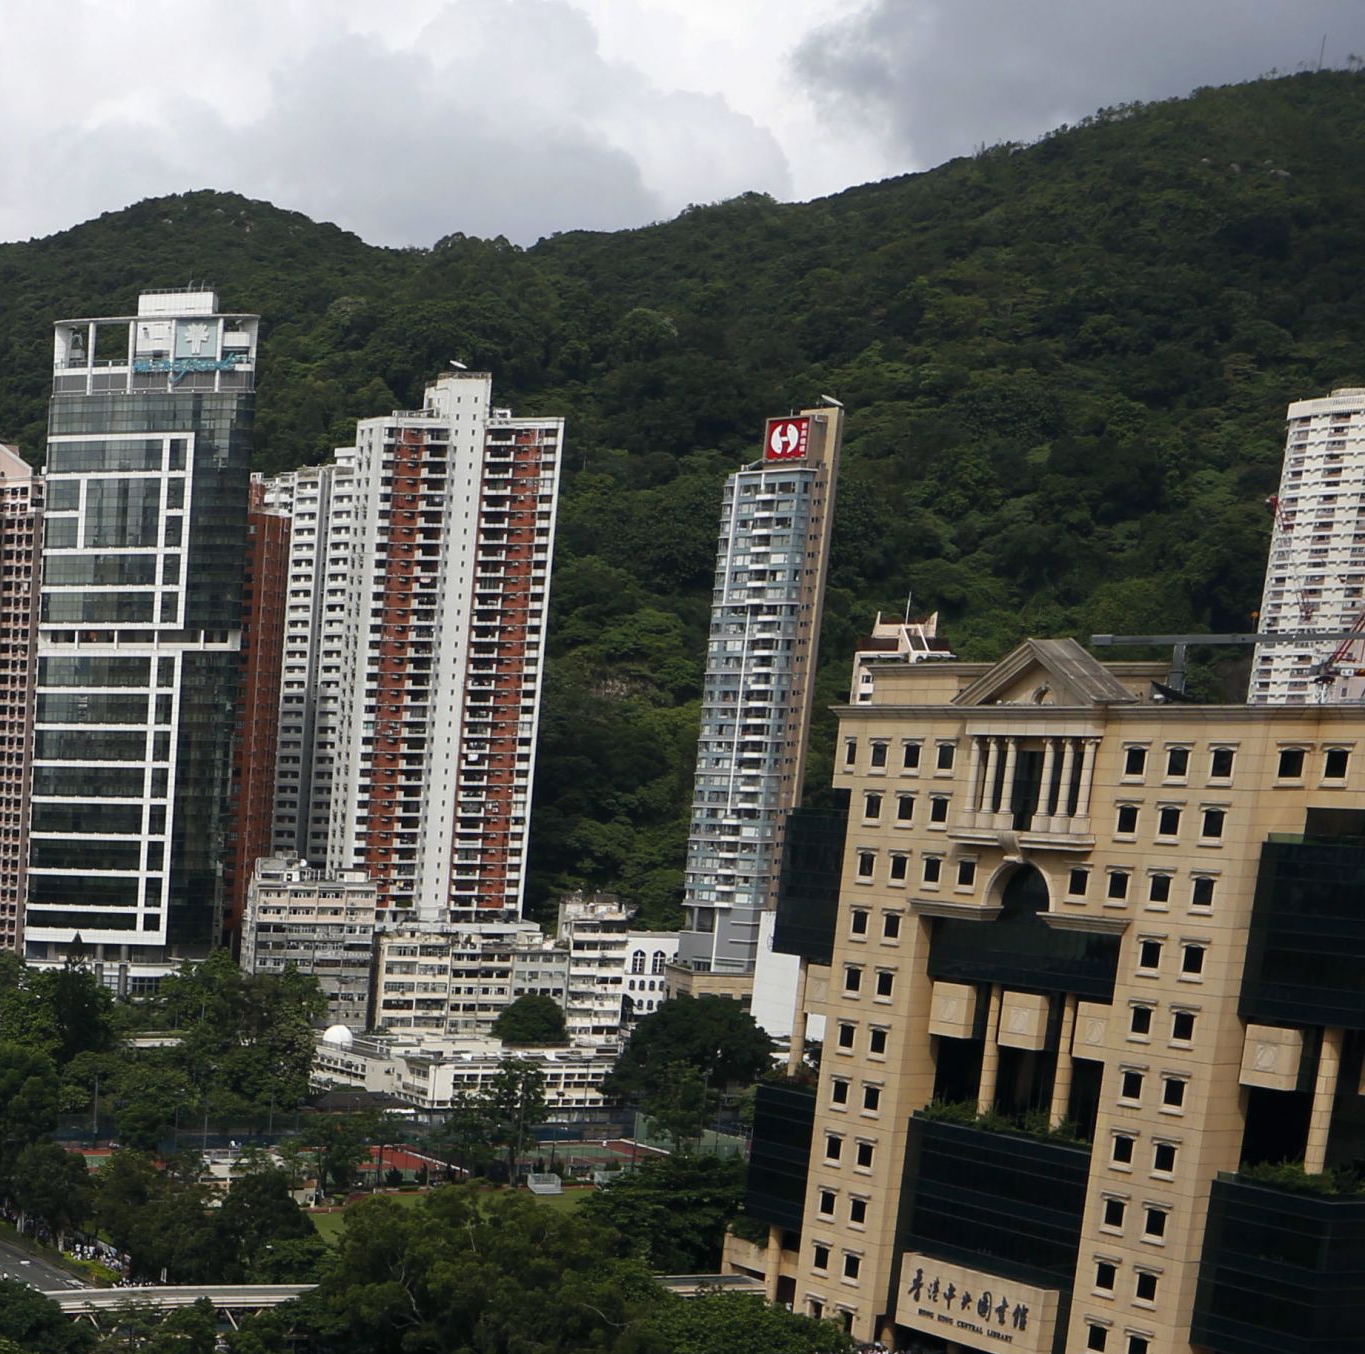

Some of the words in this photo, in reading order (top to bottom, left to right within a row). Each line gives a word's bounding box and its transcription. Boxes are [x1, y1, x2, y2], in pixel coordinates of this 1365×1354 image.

[918, 1308, 934, 1319] HONG
[937, 1314, 954, 1325] KONG
[956, 1320, 983, 1334] CENTRAL
[986, 1329, 1013, 1342] LIBRARY
